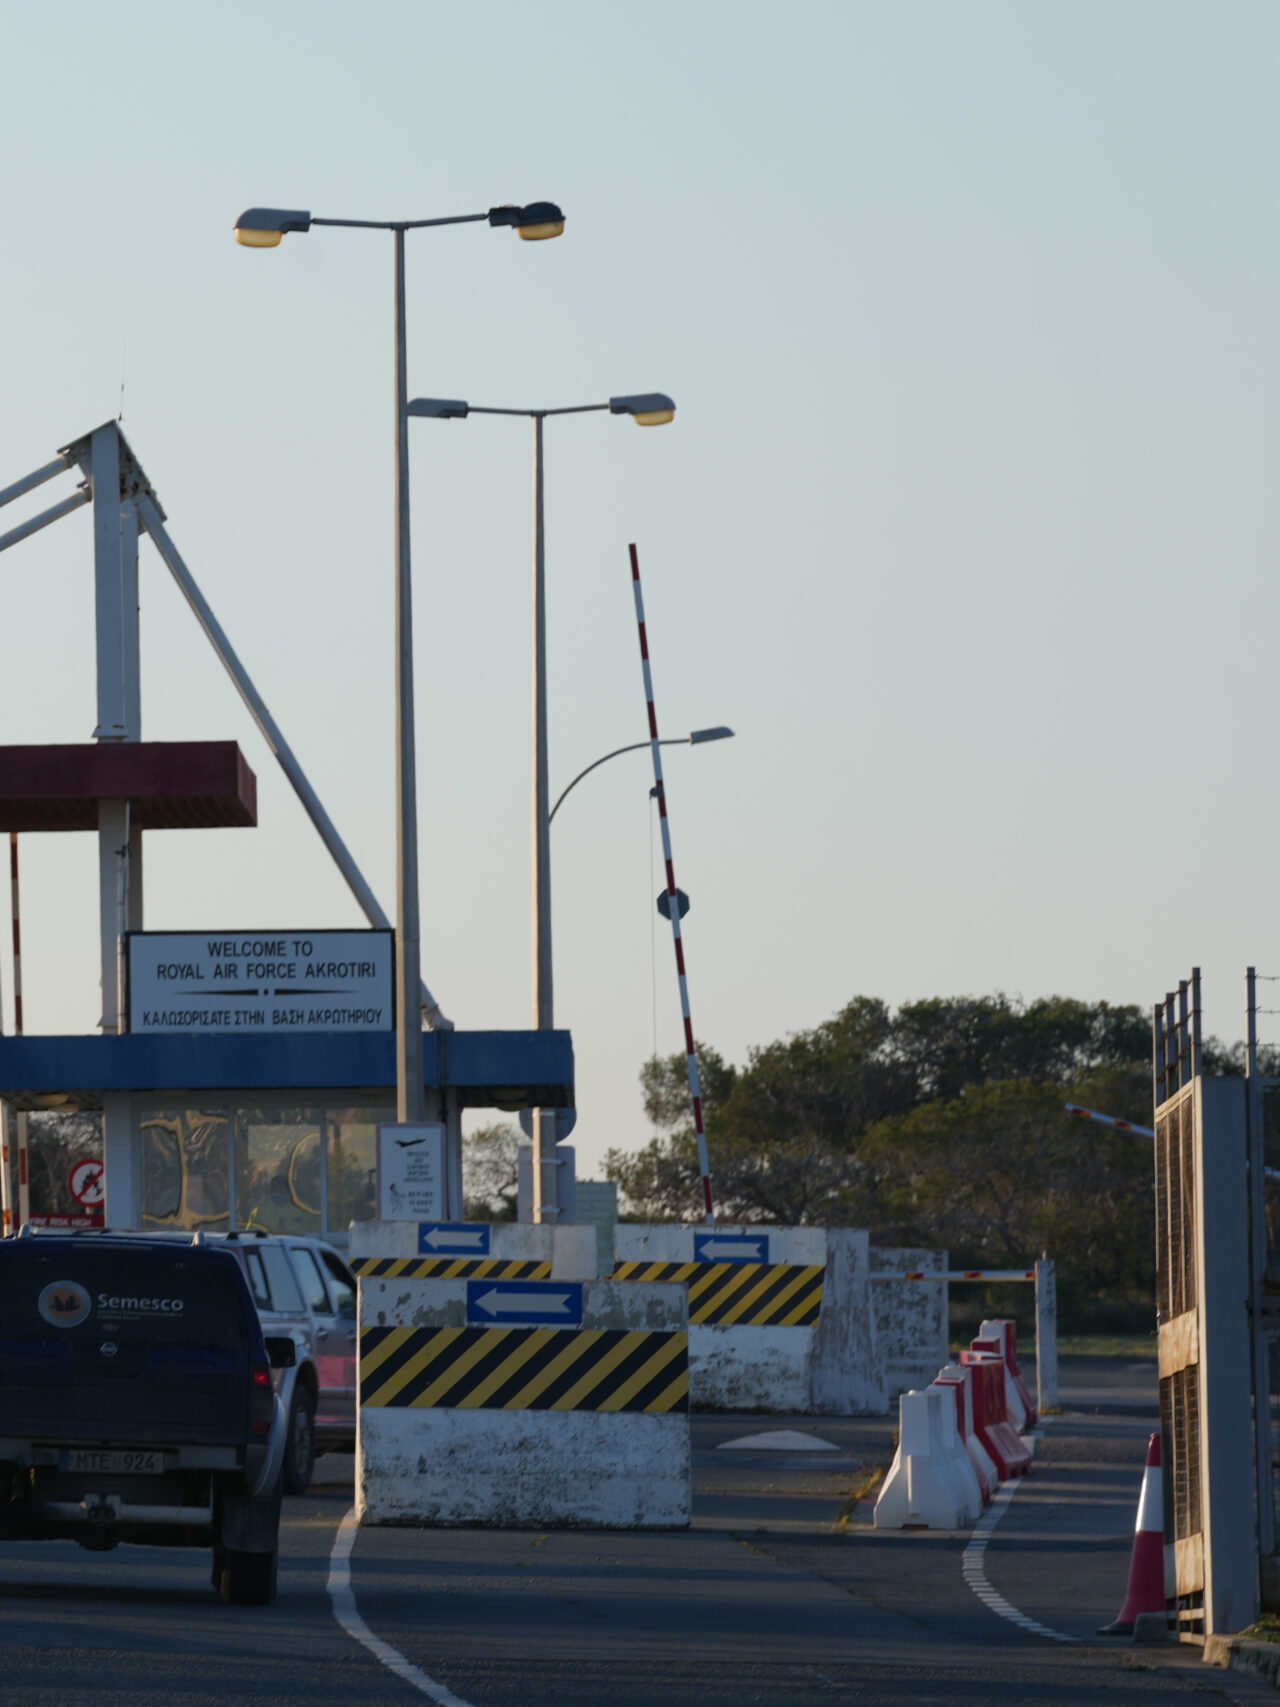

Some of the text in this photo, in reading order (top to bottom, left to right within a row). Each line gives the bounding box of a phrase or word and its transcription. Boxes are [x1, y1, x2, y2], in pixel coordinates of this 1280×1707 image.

[207, 940, 313, 957] WELCOME TO
[156, 961, 376, 980] ROYAL AIR FORCE AKROTIRI
[143, 1008, 383, 1026] ΚΑΛΩΣΟΡΙΣΑΤΕ ΣΤΗΝ ΒΑΣΗ ΑΚΡΩΤΗΡΙΟΥ
[97, 1293, 184, 1311] Semesco
[76, 1453, 156, 1471] MTE 924
